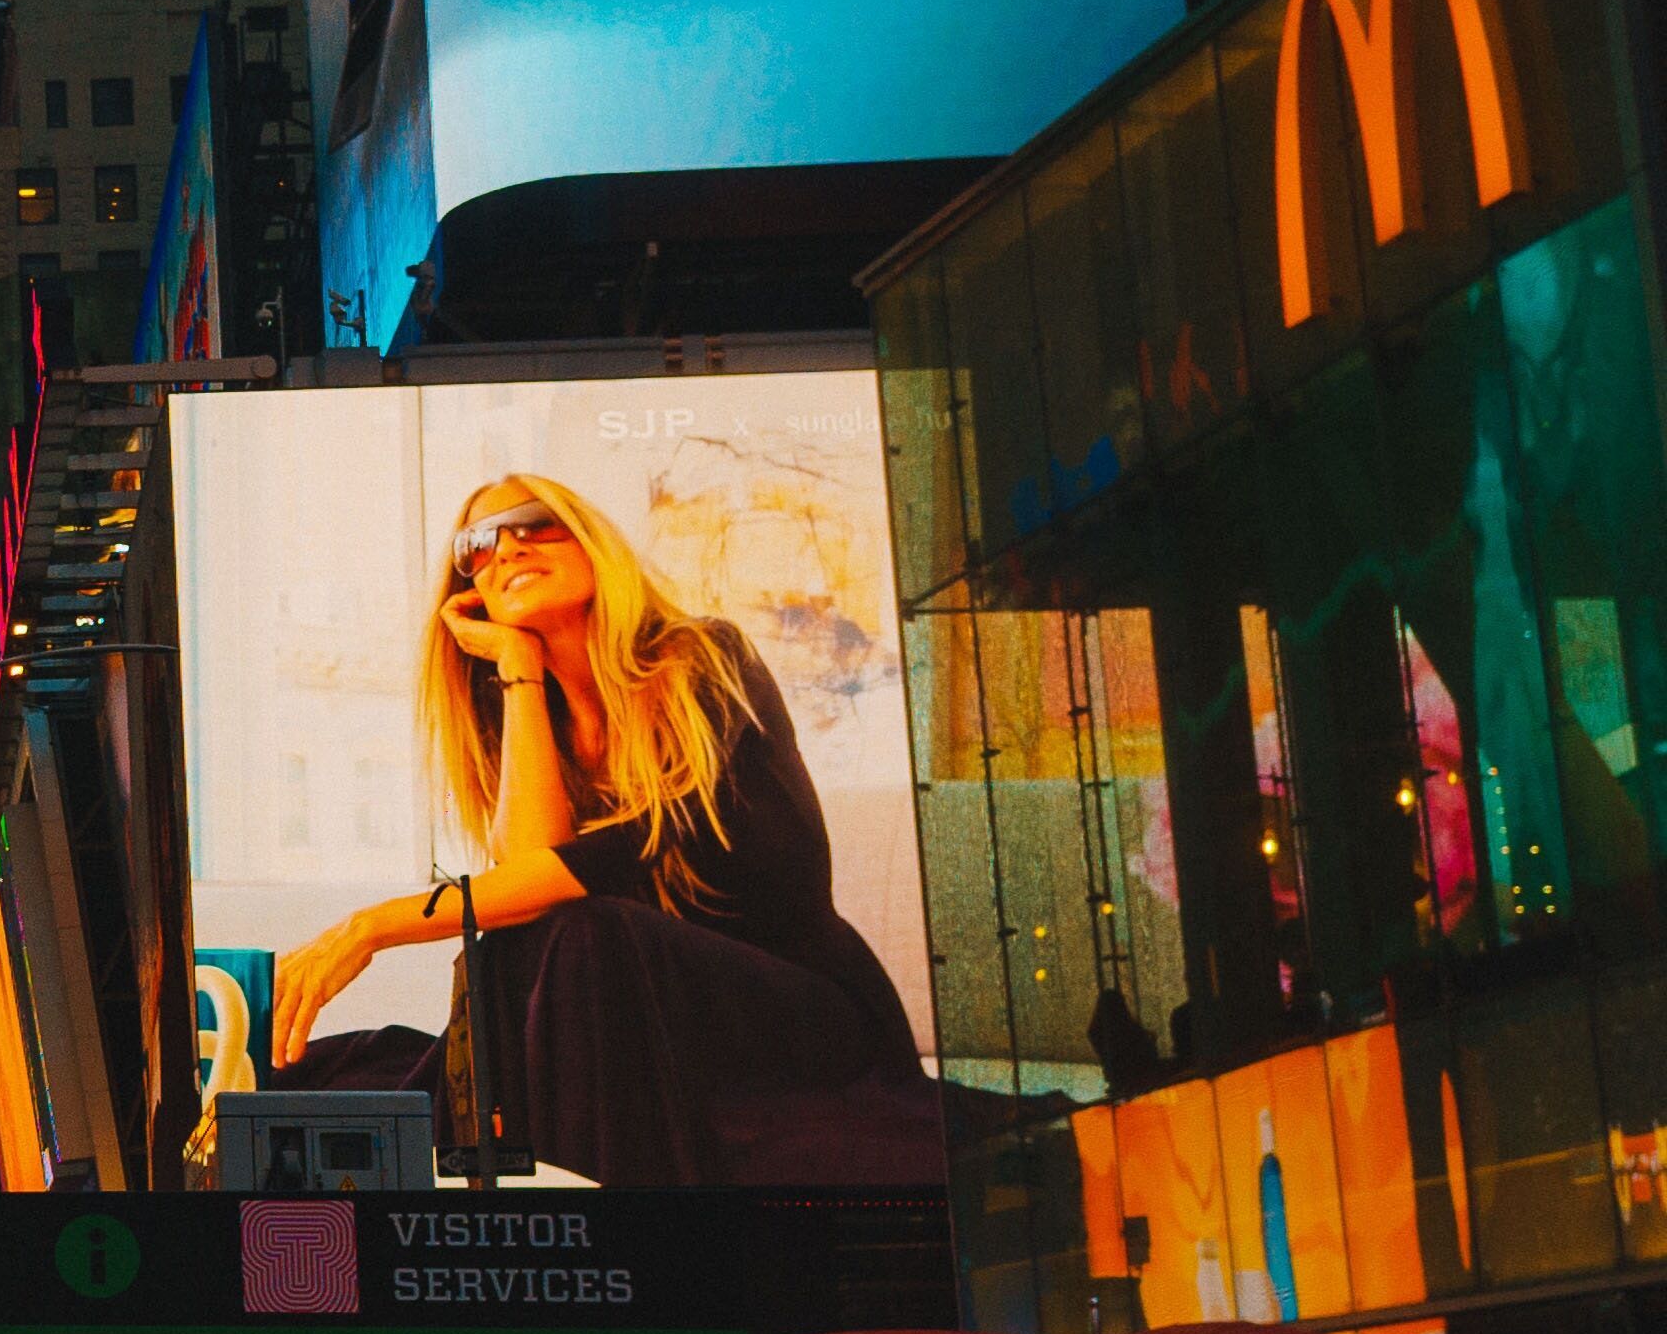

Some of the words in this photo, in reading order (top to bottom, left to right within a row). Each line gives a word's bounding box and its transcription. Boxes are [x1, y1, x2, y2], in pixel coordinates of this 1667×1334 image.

[598, 408, 695, 440] SJP
[388, 1213, 592, 1248] VISITOR
[393, 1267, 634, 1303] SERVICES
